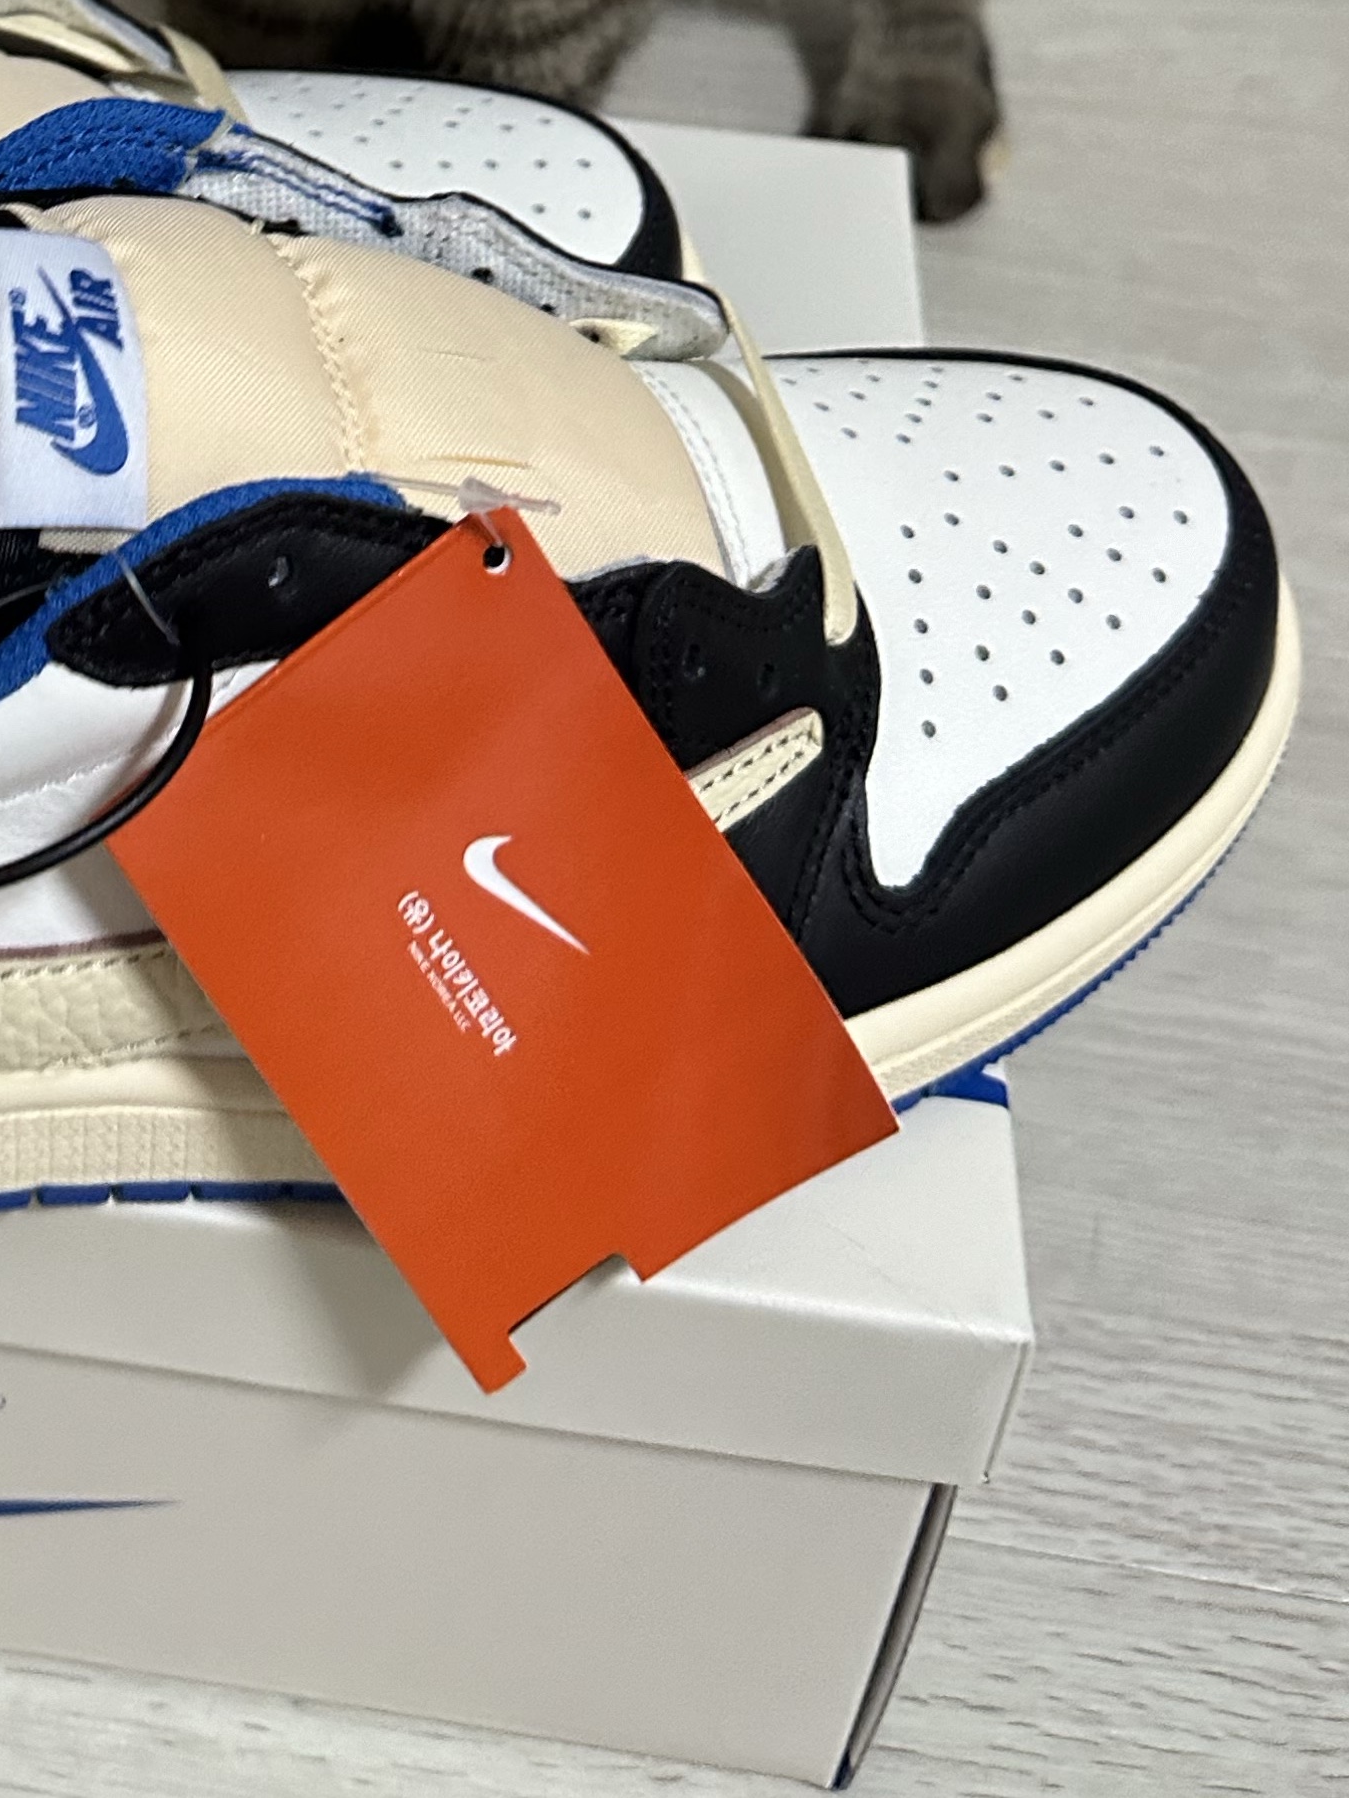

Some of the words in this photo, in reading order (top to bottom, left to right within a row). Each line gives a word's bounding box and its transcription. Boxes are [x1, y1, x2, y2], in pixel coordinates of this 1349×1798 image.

[69, 268, 124, 350] AIR
[11, 308, 78, 442] NIKE
[428, 928, 518, 1057] 나이키코리아
